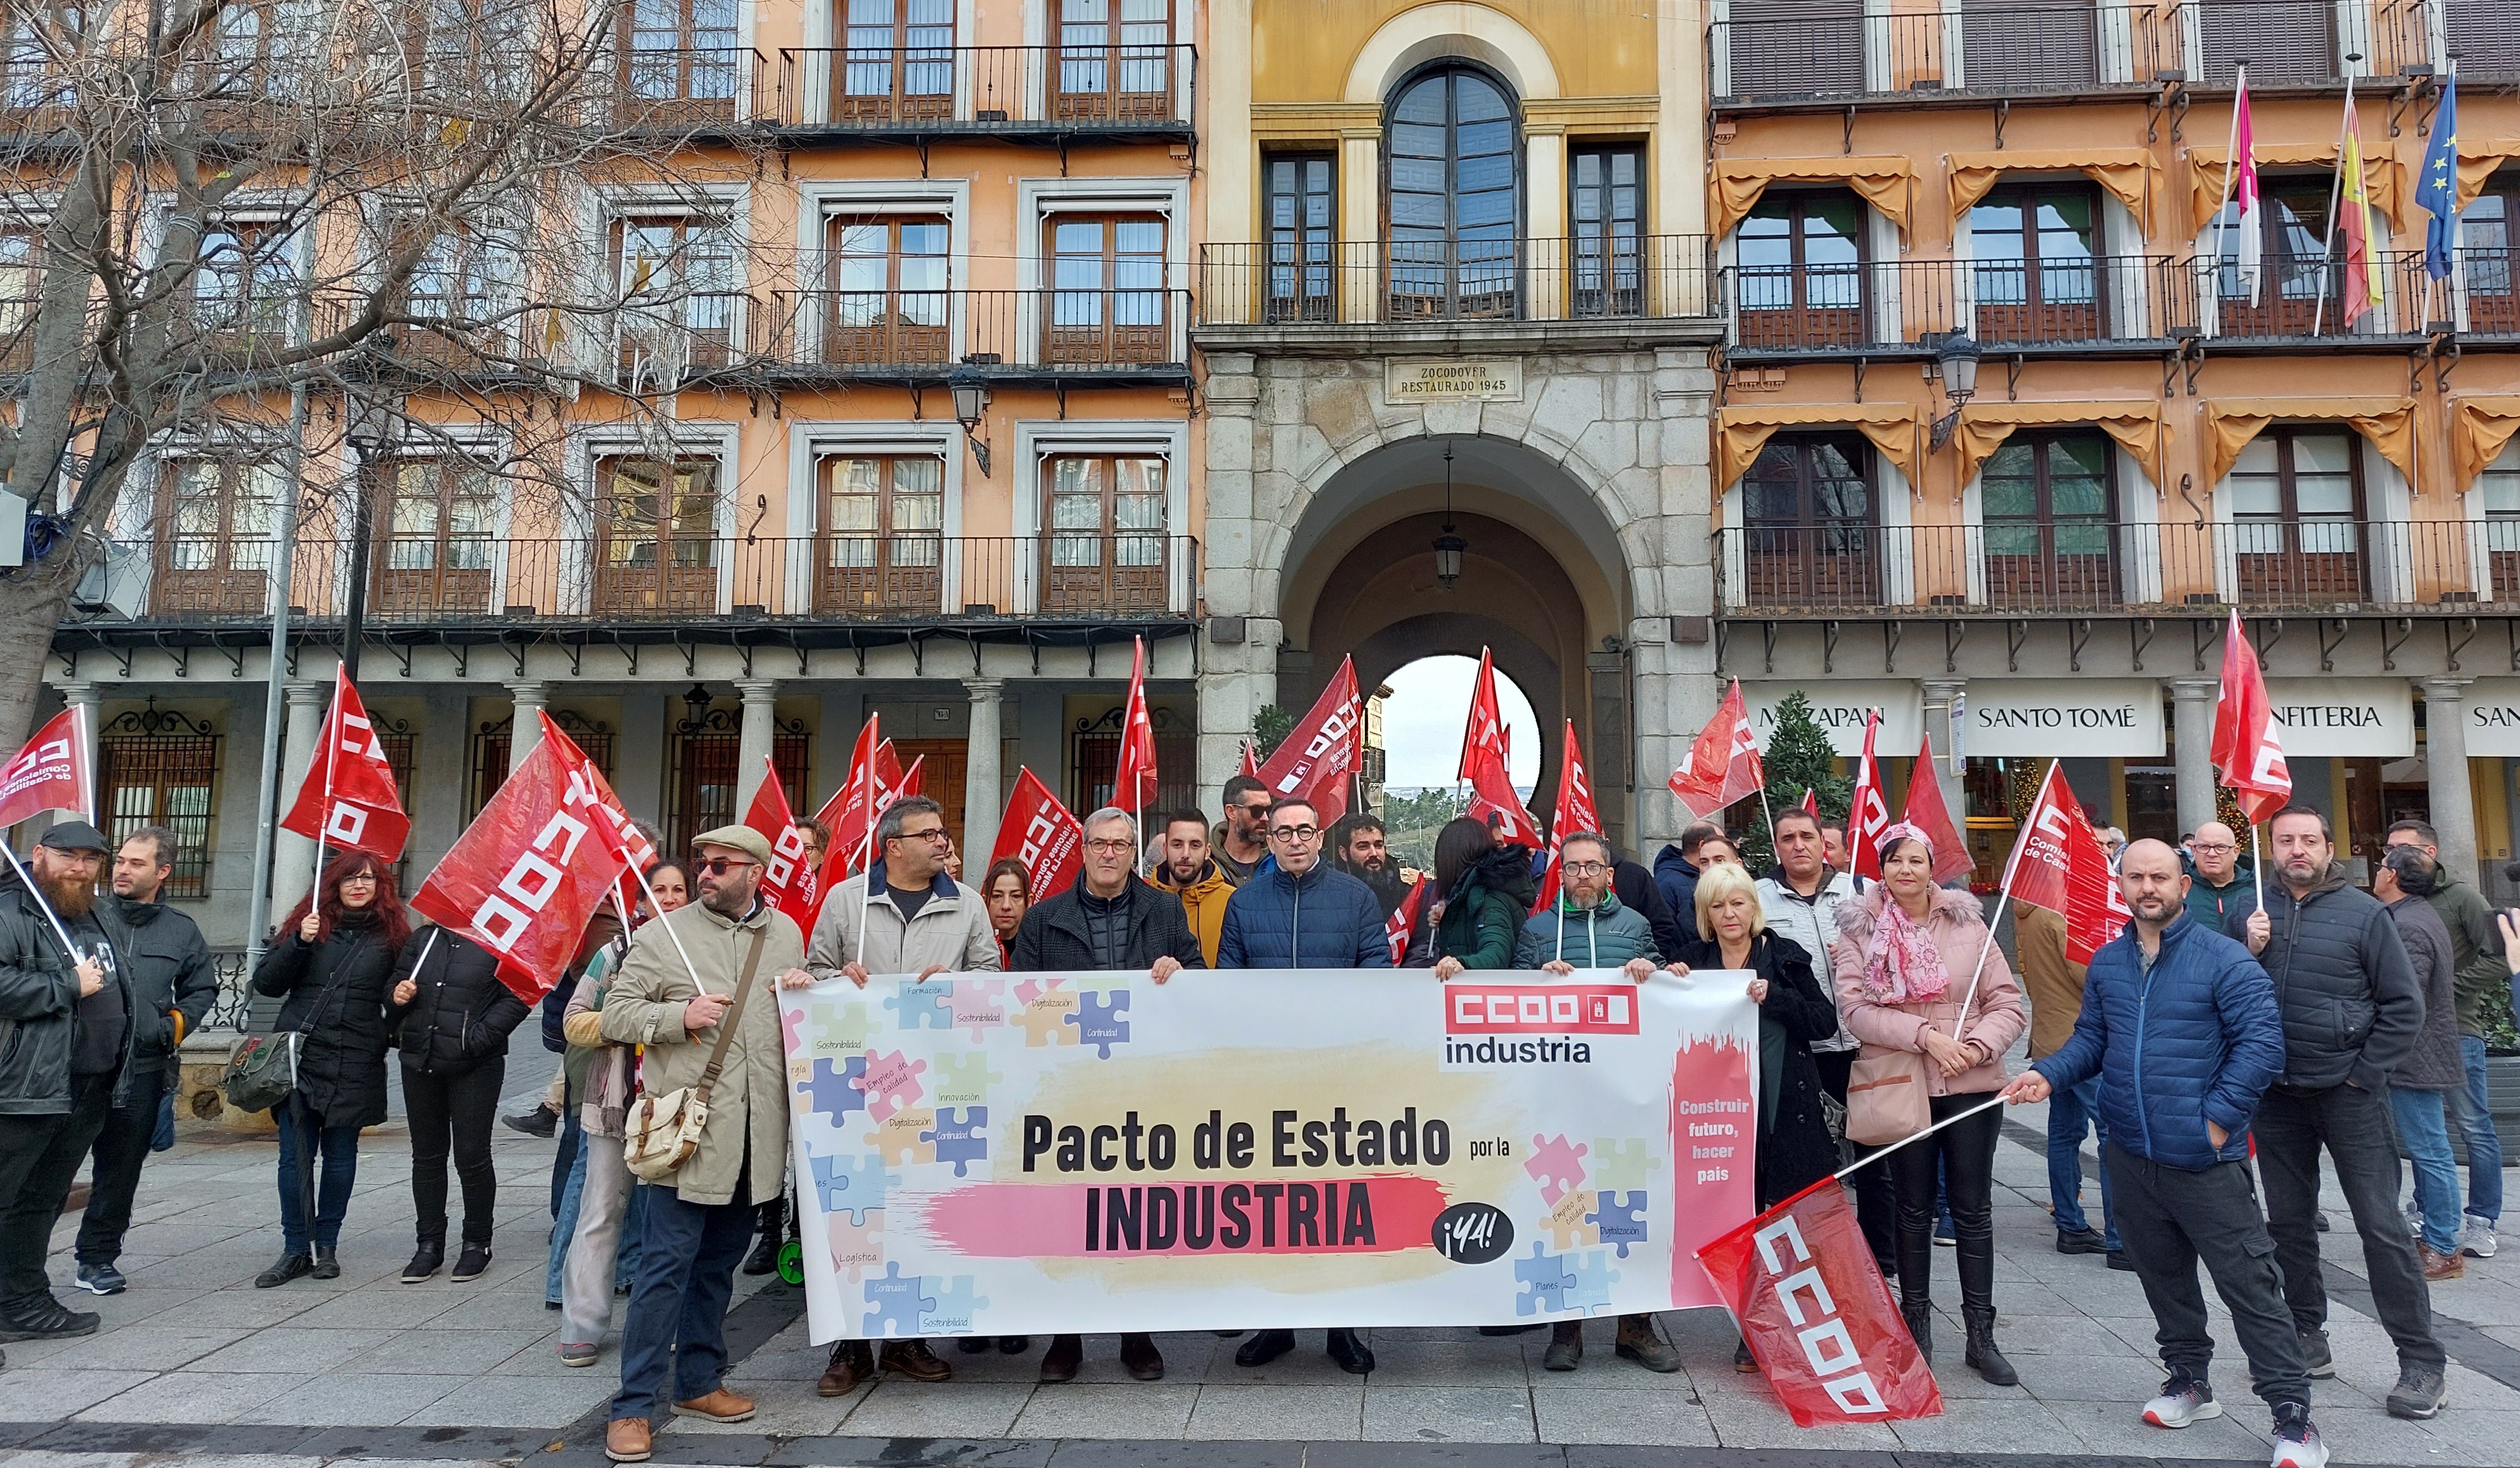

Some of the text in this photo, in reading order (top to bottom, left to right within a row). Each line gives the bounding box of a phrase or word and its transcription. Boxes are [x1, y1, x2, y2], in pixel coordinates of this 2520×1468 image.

[1402, 380, 1506, 393] RESTAURADO 1945
[1759, 707, 1885, 727] MZAPAN
[1979, 704, 2137, 728] SANTO TOMÉ
[2269, 706, 2383, 727] NFITERIA
[2024, 847, 2040, 859] de
[1032, 998, 1072, 1010] Digitalización
[1455, 995, 1580, 1024] CCOO
[957, 1013, 1000, 1023] Sostenibilidad
[1087, 1028, 1118, 1037] Continuidad
[816, 1040, 862, 1049] Sostenibilidad
[1446, 1036, 1591, 1063] industria
[866, 1061, 907, 1090] Empleo de
[883, 1073, 909, 1094] calidad
[938, 1092, 980, 1102] Innovación
[1680, 1098, 1749, 1115] Construir
[889, 1117, 931, 1130] Digitalización
[1688, 1122, 1739, 1138] futuro,
[936, 1131, 968, 1140] Continuidad
[1022, 1106, 1510, 1172] Pacto de Estado por la
[1692, 1145, 1734, 1159] hacer
[1552, 1193, 1585, 1222] Empleo de
[1566, 1204, 1586, 1225] calidad
[1086, 1182, 1377, 1251] INDUSTRIA
[1443, 1212, 1498, 1258] ¡YA!
[1600, 1227, 1639, 1238] Digitalización
[839, 1252, 877, 1265] Logística
[874, 1283, 907, 1293] Continuidad
[1536, 1281, 1558, 1291] Planes
[1753, 1215, 1890, 1414] CCOO
[923, 1317, 968, 1328] Sostenibilidad
